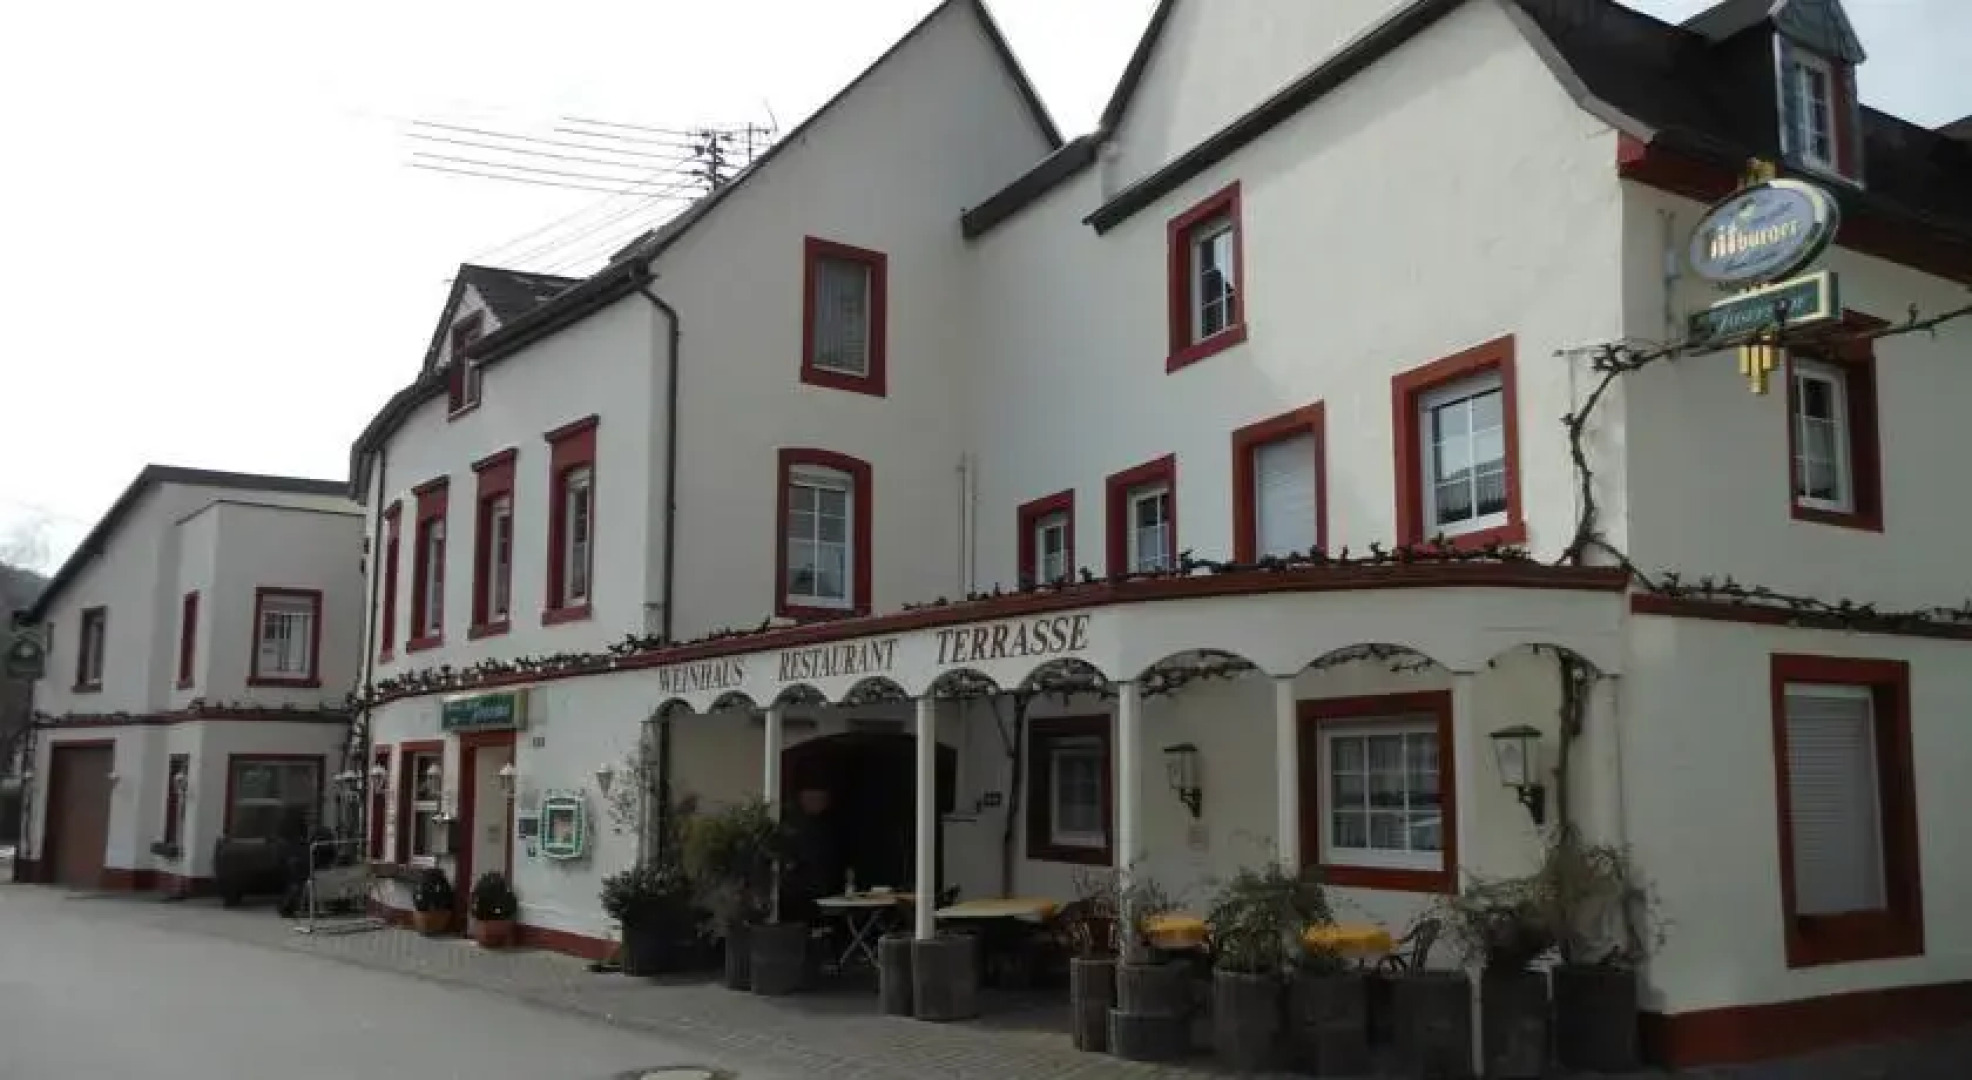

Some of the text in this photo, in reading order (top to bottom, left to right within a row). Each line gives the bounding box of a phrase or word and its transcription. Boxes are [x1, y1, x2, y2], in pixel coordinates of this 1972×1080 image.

[659, 614, 1090, 693] WEINHAUS RESTAURANT TERRASSE
